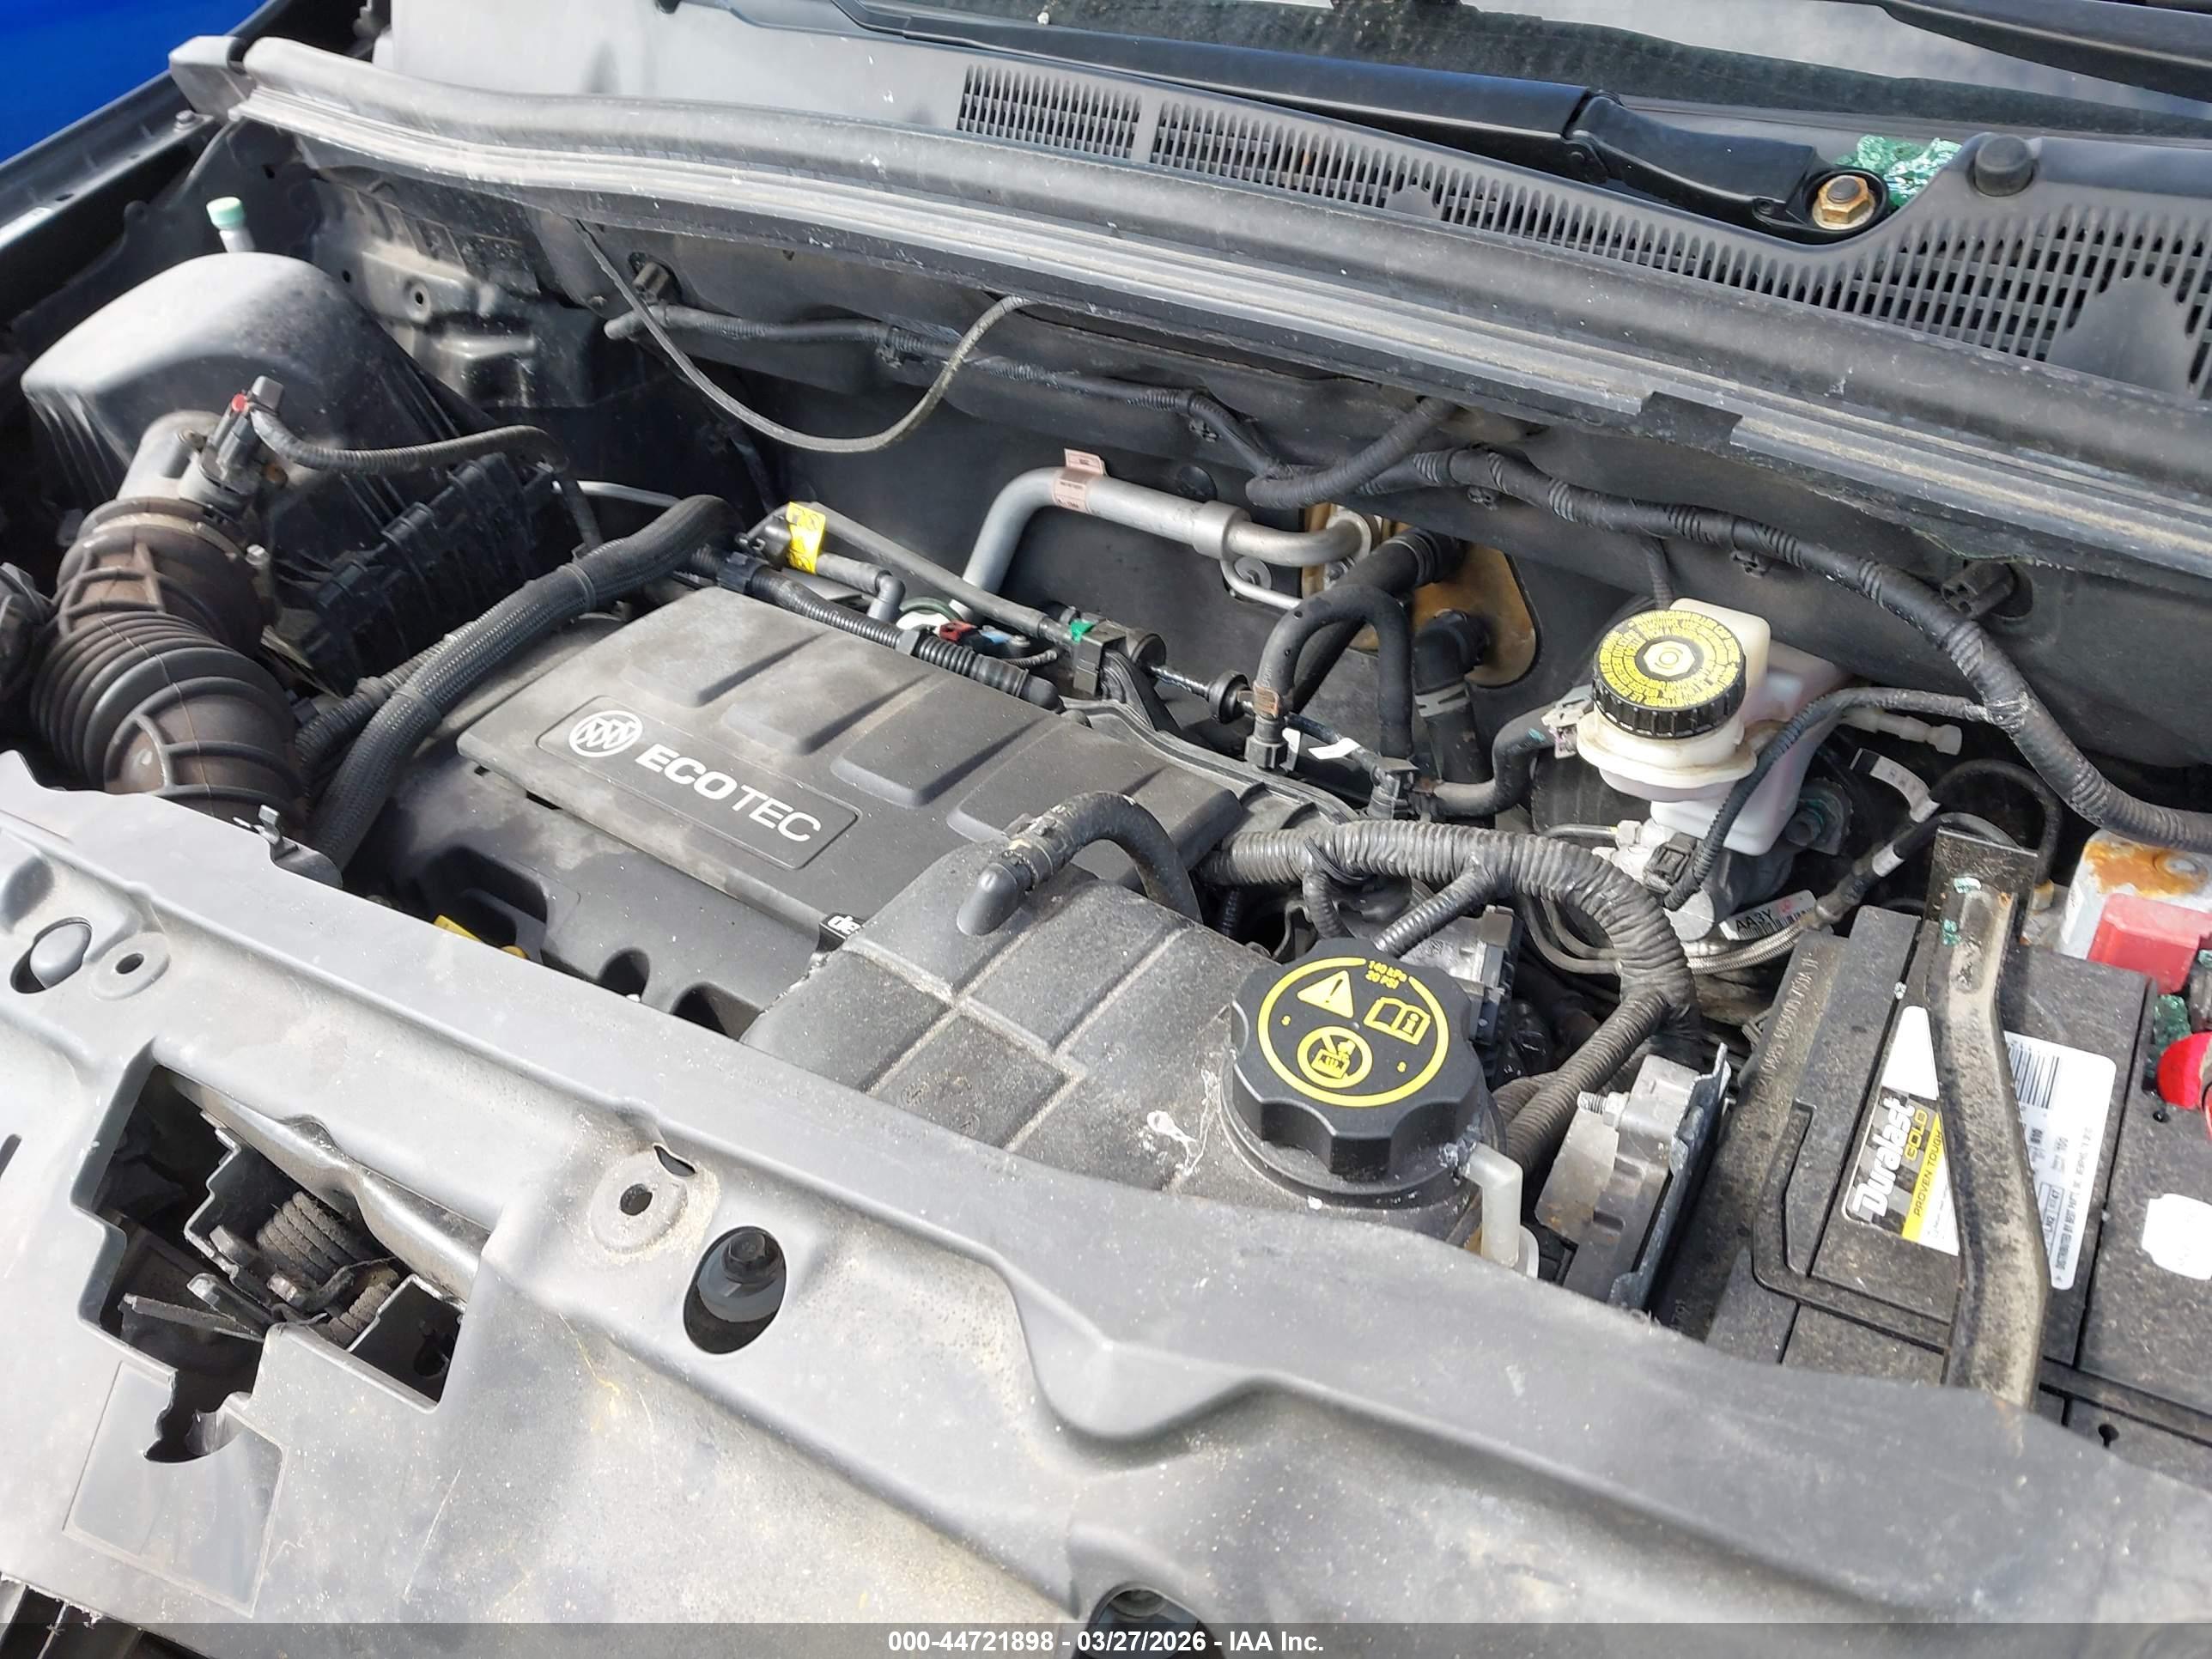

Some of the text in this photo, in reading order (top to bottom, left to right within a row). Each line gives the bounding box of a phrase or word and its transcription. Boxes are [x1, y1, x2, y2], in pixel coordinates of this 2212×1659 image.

[635, 744, 822, 842] ECOTEC
[1735, 908, 1773, 933] AA3Y
[1852, 1096, 1916, 1218] Duralast
[1904, 1109, 1928, 1162] GOLD
[1913, 1170, 1933, 1217] PROVEN
